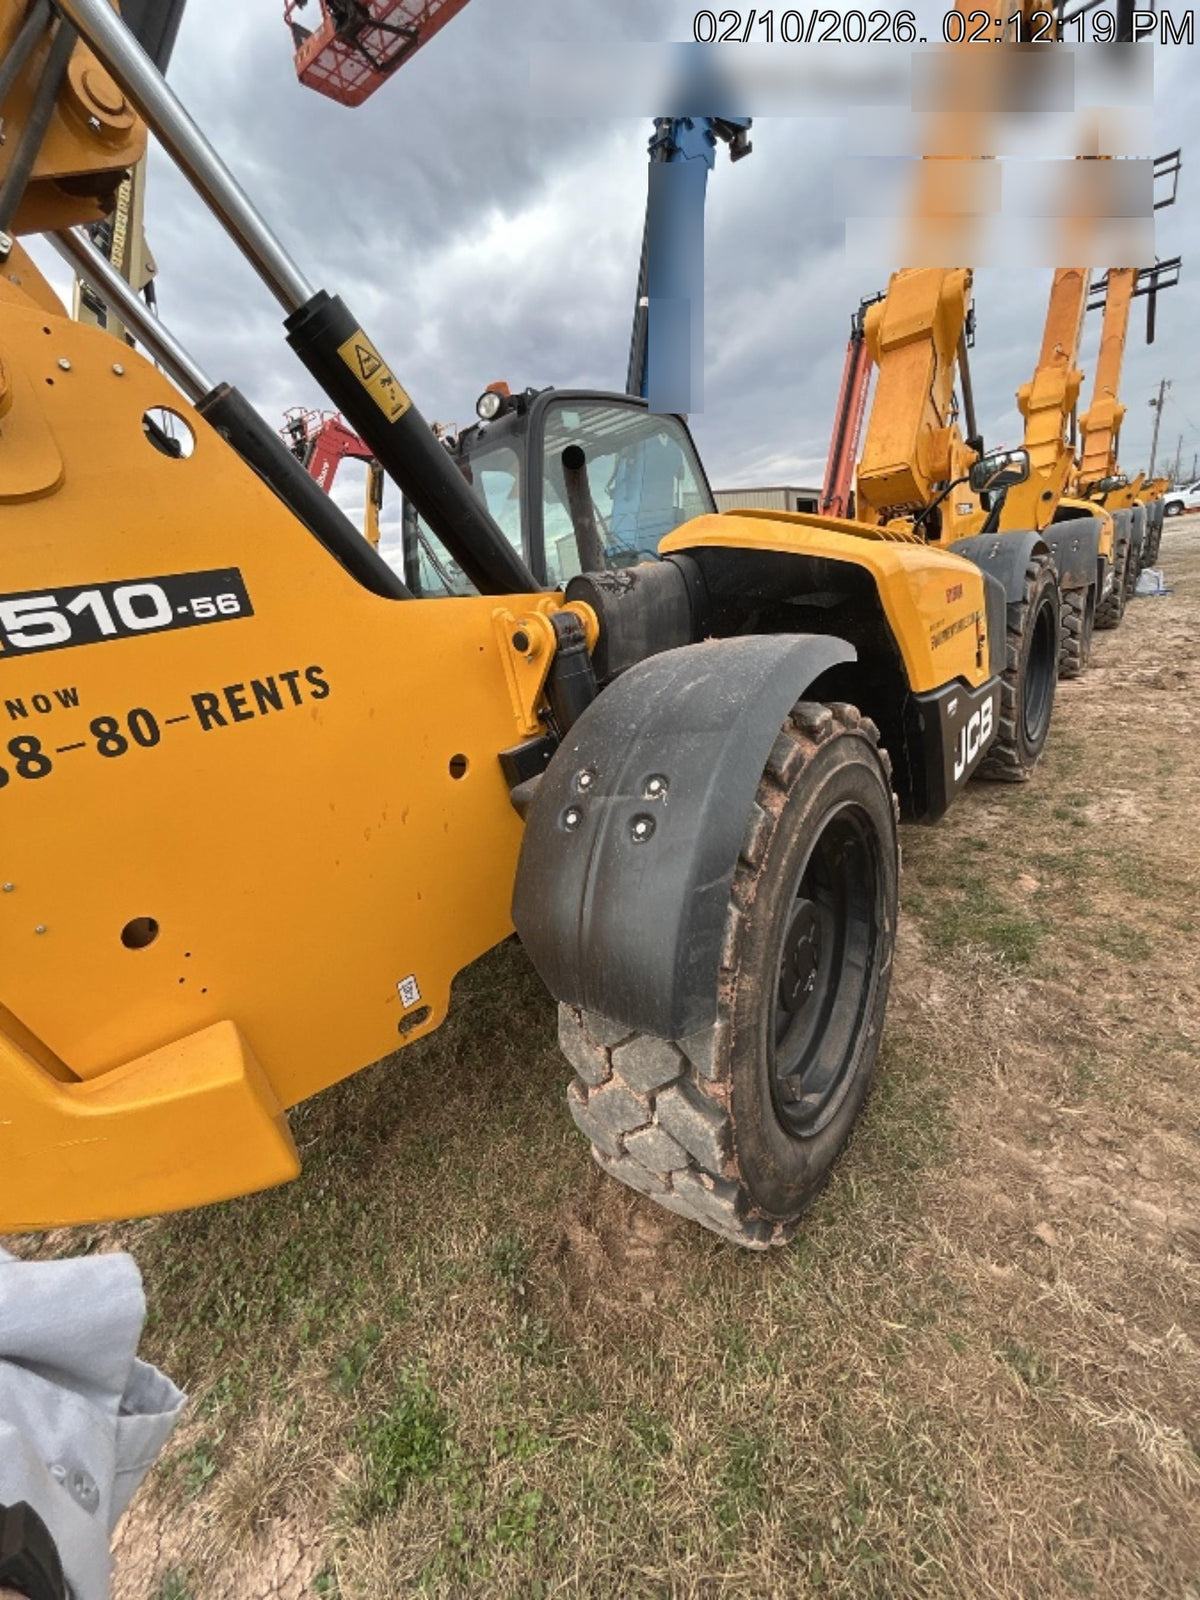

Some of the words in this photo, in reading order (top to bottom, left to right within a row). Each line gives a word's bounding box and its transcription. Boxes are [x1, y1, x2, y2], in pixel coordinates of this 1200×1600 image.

[0, 665, 330, 789] 8-80-RENTS
[5, 686, 79, 720] NOW
[954, 696, 993, 781] JCB
